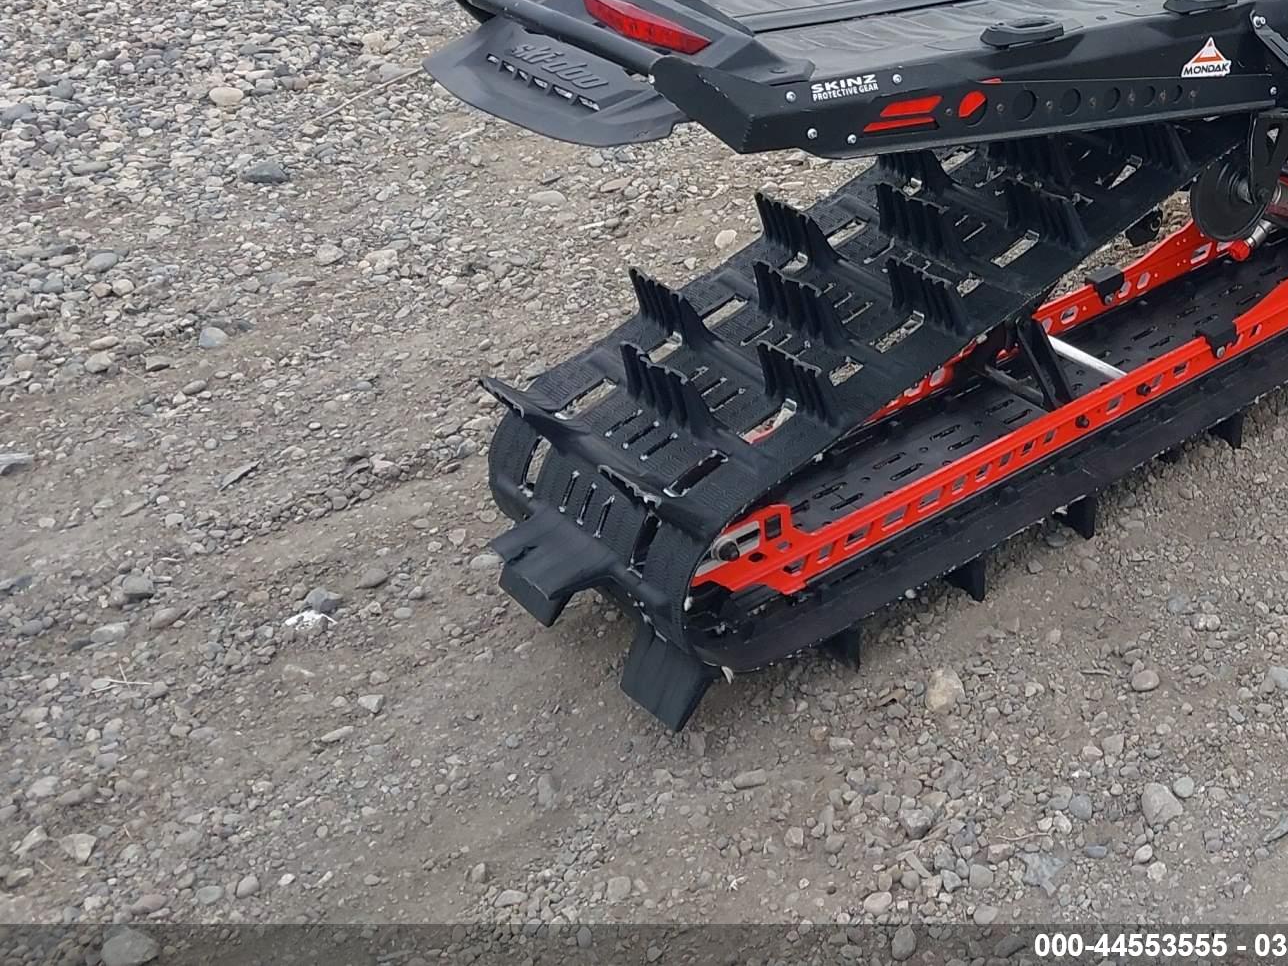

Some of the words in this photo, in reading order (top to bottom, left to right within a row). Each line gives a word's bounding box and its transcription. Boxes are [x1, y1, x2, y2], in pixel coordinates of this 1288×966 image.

[1183, 62, 1230, 76] MONDAK
[811, 74, 876, 94] SKINZ
[812, 86, 860, 102] PROTECTIVE
[860, 83, 879, 94] GEAR
